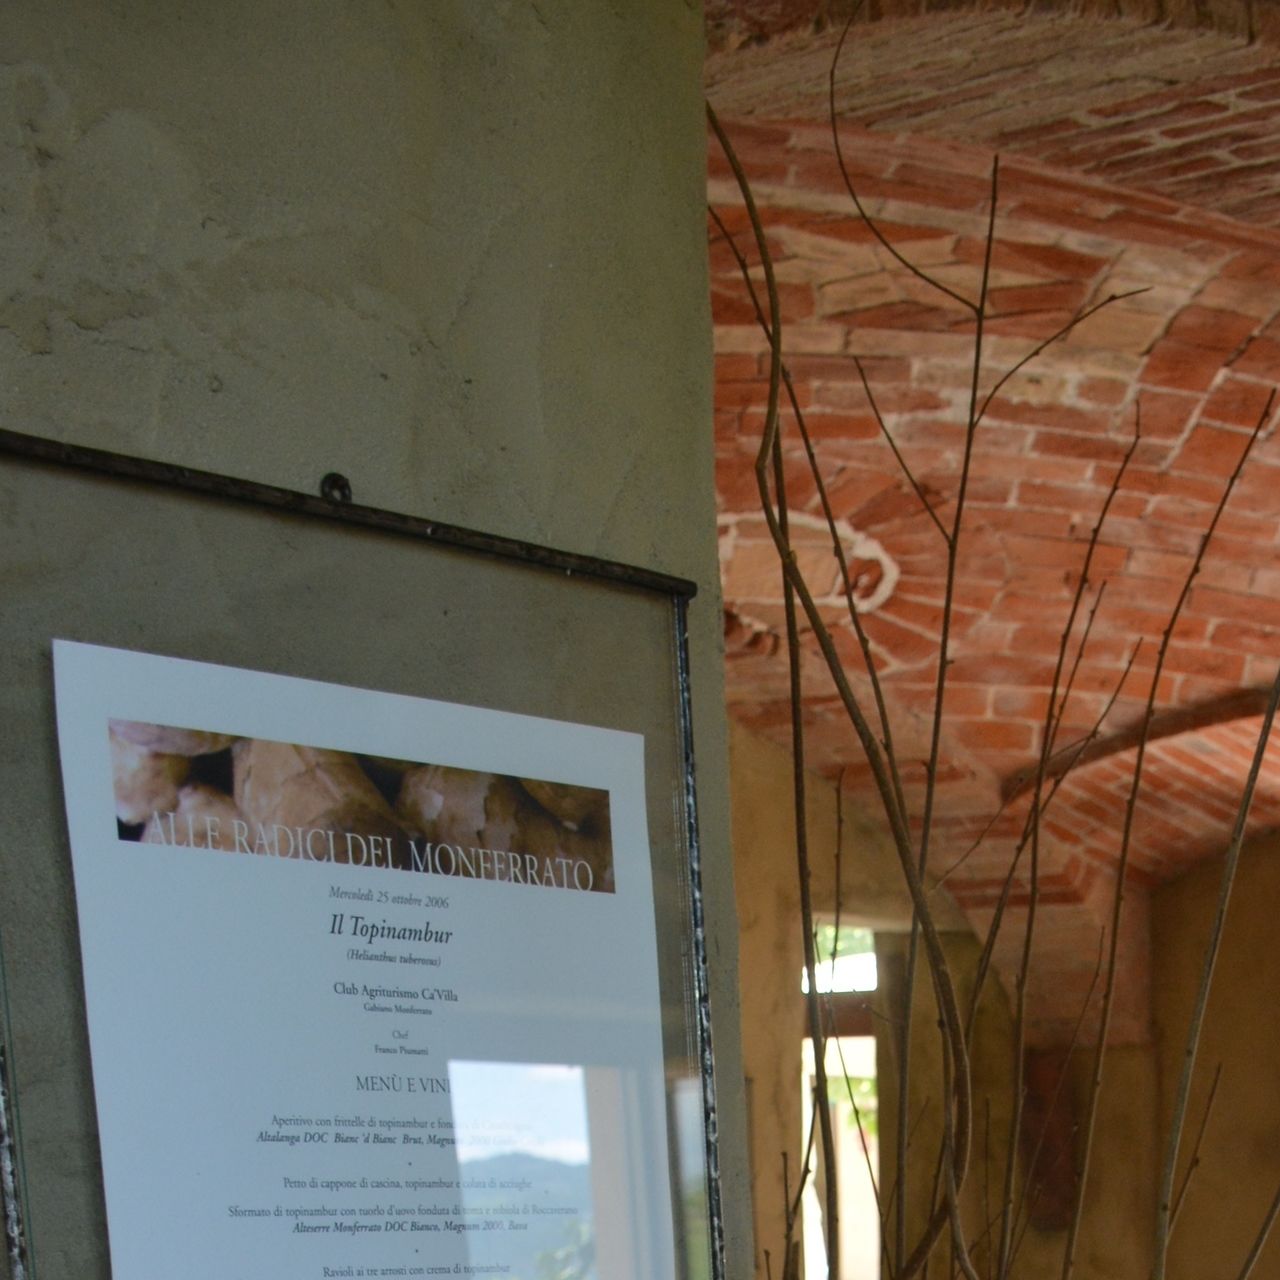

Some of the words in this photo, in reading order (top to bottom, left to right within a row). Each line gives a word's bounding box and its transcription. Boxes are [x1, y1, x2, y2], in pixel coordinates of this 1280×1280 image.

[150, 811, 225, 850] ALLE
[232, 818, 337, 863] RADICI
[344, 832, 402, 869] DEL
[408, 839, 595, 891] MONFERRATO
[377, 890, 390, 904] 25
[391, 893, 423, 907] ottobre
[424, 895, 450, 909] 2006
[329, 913, 344, 935] Il
[350, 915, 454, 944] Topinambur
[333, 982, 359, 996] Club
[361, 984, 419, 1000] Agriturismo
[356, 1074, 401, 1092] MENÙ
[407, 1077, 416, 1093] E
[271, 1114, 313, 1129] Aperitivo
[315, 1117, 332, 1127] con
[367, 1117, 377, 1128] di
[379, 1117, 428, 1130] topinambur
[304, 1132, 328, 1144] DOC
[283, 1177, 307, 1189] Petto
[309, 1177, 318, 1189] di
[320, 1180, 357, 1192] cappone
[359, 1177, 368, 1189] di
[405, 1177, 454, 1191] topinambur
[228, 1205, 271, 1217] Sformato
[273, 1205, 283, 1217] di
[285, 1205, 338, 1219] topinambur
[340, 1207, 357, 1217] con
[452, 1204, 461, 1216] di
[333, 1221, 382, 1236] Monferrato
[384, 1220, 408, 1232] DOC
[323, 1266, 354, 1278] Ravioli
[356, 1267, 364, 1277] ai
[366, 1267, 378, 1277] tre
[409, 1267, 424, 1276] con
[426, 1266, 451, 1275] crema
[453, 1263, 461, 1275] di
